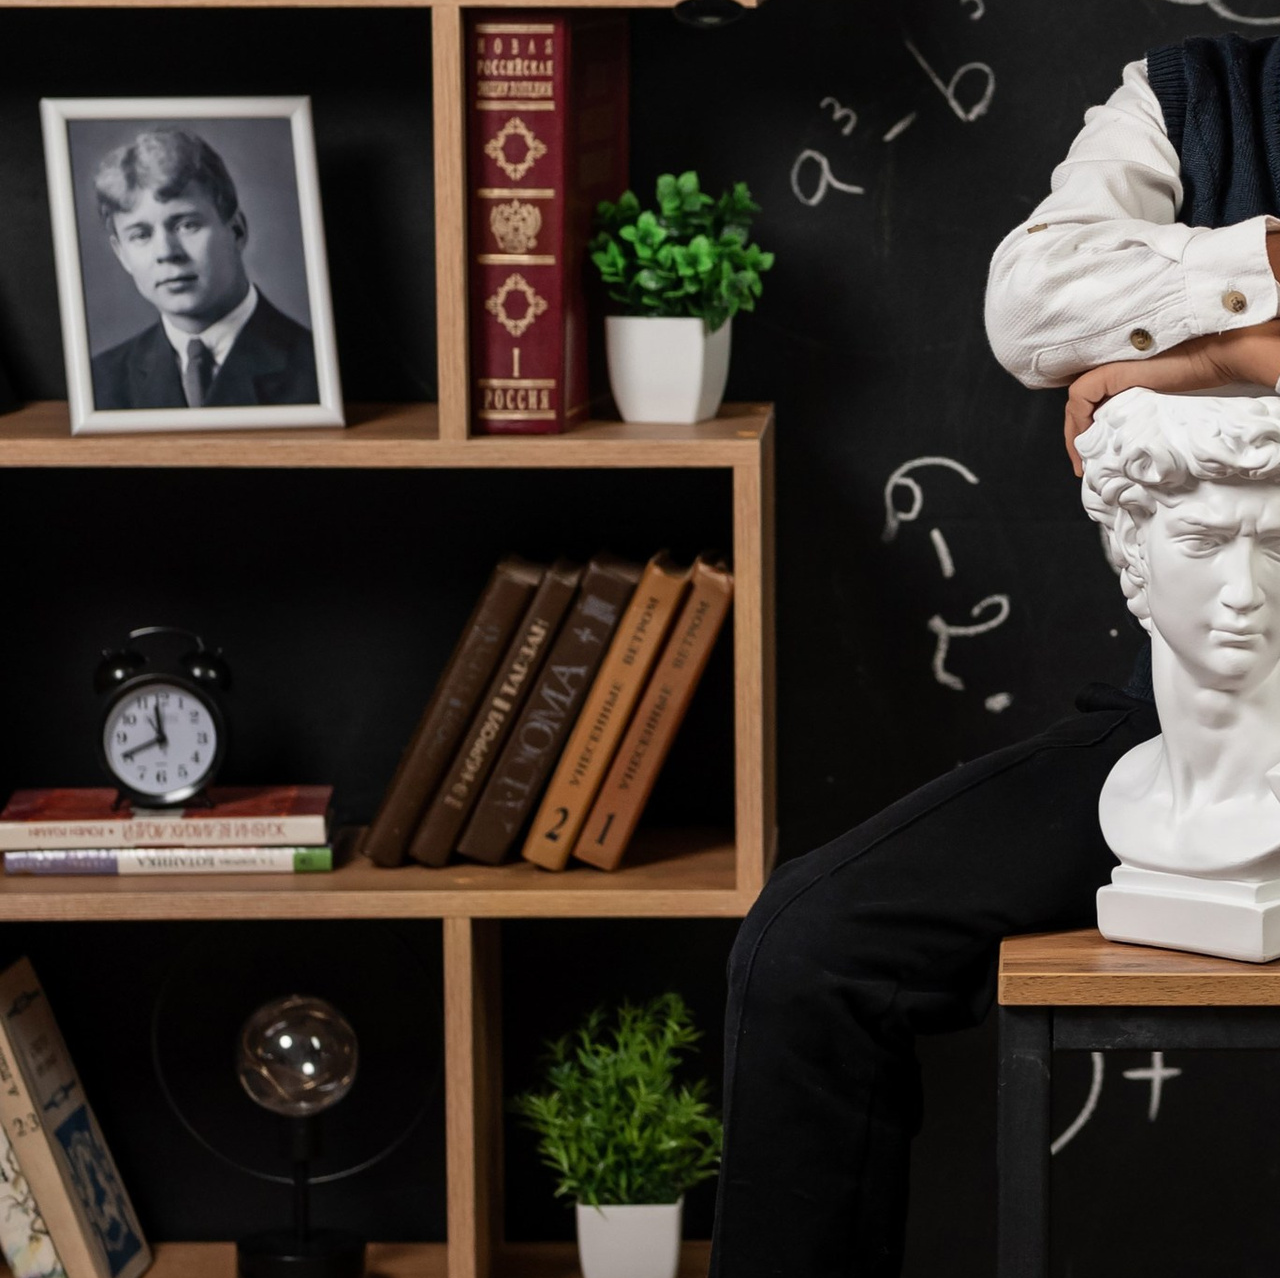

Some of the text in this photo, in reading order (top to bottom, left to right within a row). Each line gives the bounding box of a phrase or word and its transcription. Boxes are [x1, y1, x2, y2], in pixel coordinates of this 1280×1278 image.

[477, 39, 553, 55] НОВАЯ
[477, 58, 553, 77] РОССИЙСКАЯ
[484, 389, 550, 410] РОССИЯ
[569, 595, 661, 788] УНЕСЕННЫЕ ВЕТРОМ
[618, 684, 674, 791] УНЕСЕННЫЕ
[544, 807, 570, 842] 2
[595, 812, 616, 846] 1
